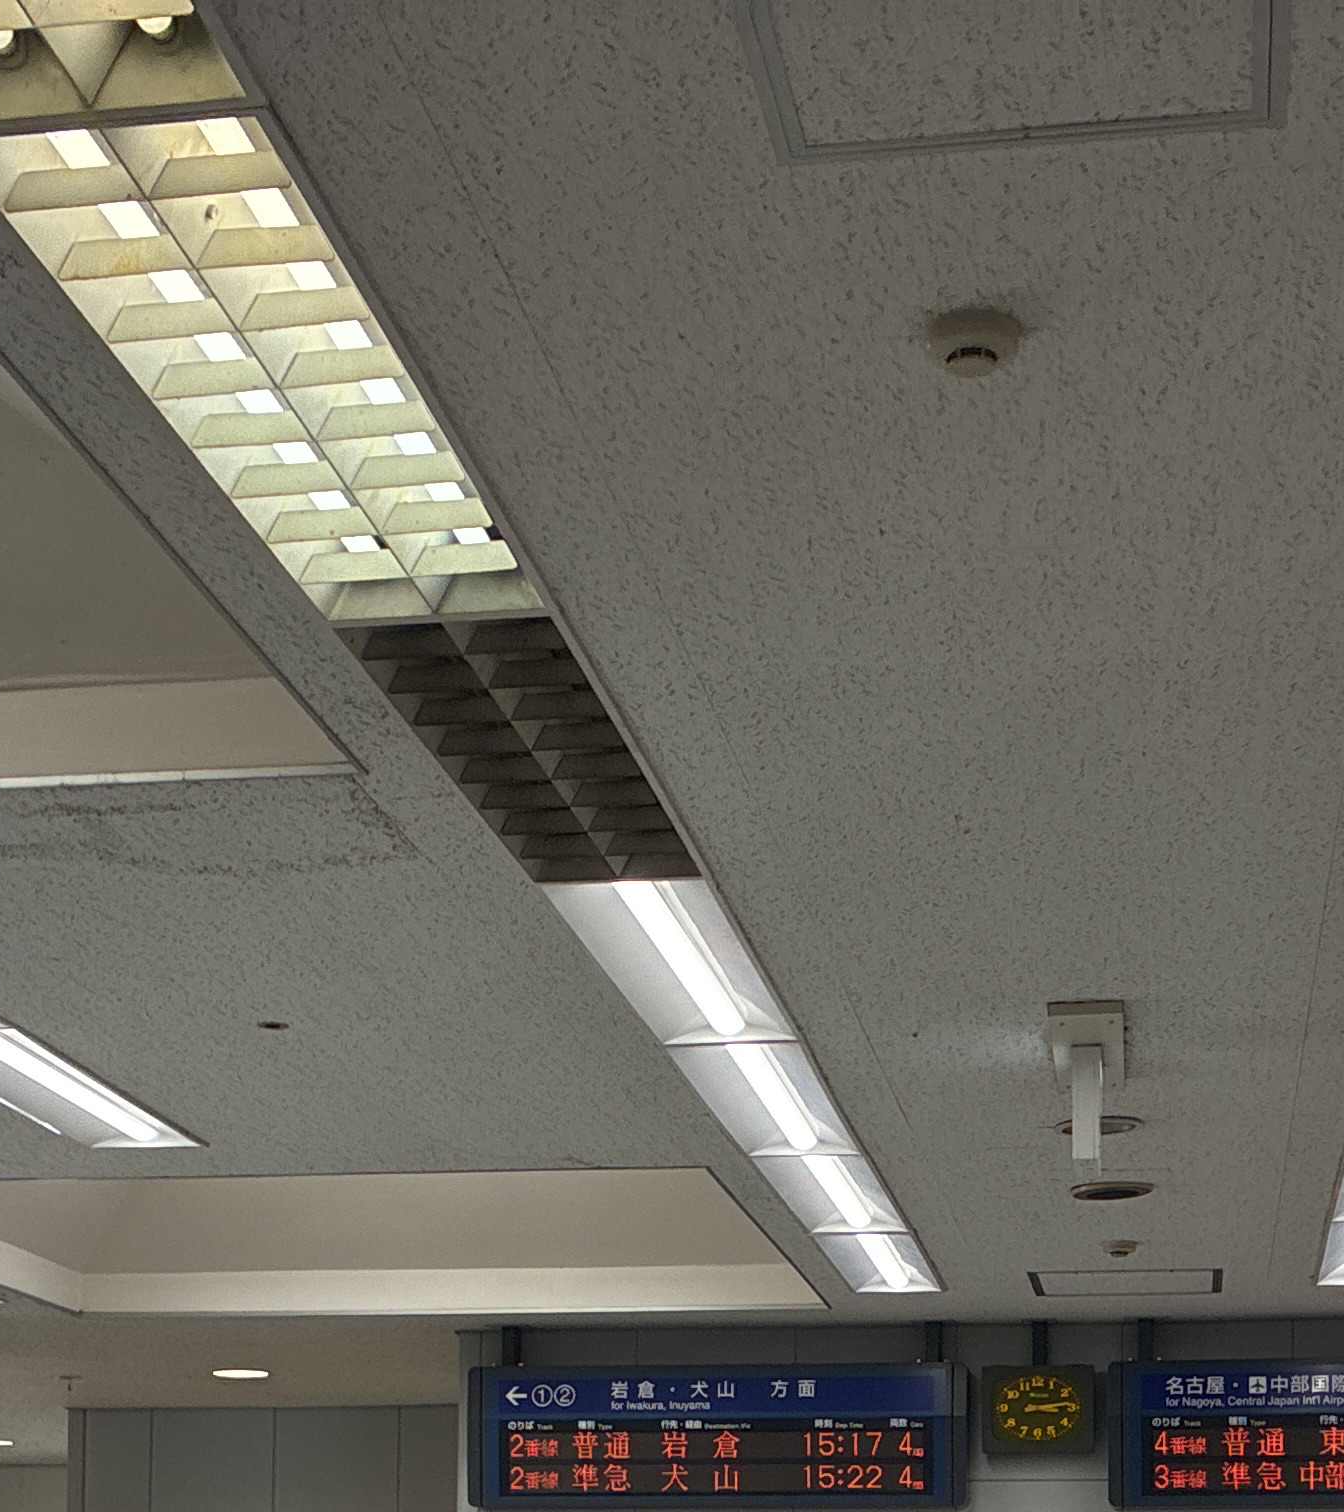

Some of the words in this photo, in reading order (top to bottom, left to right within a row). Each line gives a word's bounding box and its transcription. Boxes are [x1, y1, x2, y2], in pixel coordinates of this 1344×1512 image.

[610, 1380, 735, 1399] 岩倉・犬山
[770, 1379, 817, 1399] 方面
[610, 1401, 624, 1411] for
[626, 1401, 666, 1412] Iwakura,
[669, 1401, 711, 1412] Inuyama
[1165, 1397, 1180, 1406] for
[1182, 1396, 1225, 1408] Nagoya,
[1227, 1396, 1265, 1406] Central
[1267, 1396, 1301, 1407] Japan
[507, 1421, 535, 1430] のりば
[1152, 1417, 1180, 1427] のりば
[510, 1433, 558, 1458] 2番線
[572, 1431, 631, 1459] 普通
[660, 1431, 740, 1459] 岩倉
[803, 1432, 882, 1457] 15:17
[1154, 1430, 1206, 1455] 4番線
[1221, 1427, 1286, 1456] 普通
[510, 1466, 558, 1490] 2番線
[572, 1463, 631, 1492] 準急
[661, 1464, 739, 1492] 犬山
[803, 1465, 882, 1489] 15:22
[1154, 1464, 1206, 1489] 3番線
[1221, 1461, 1286, 1490] 準急
